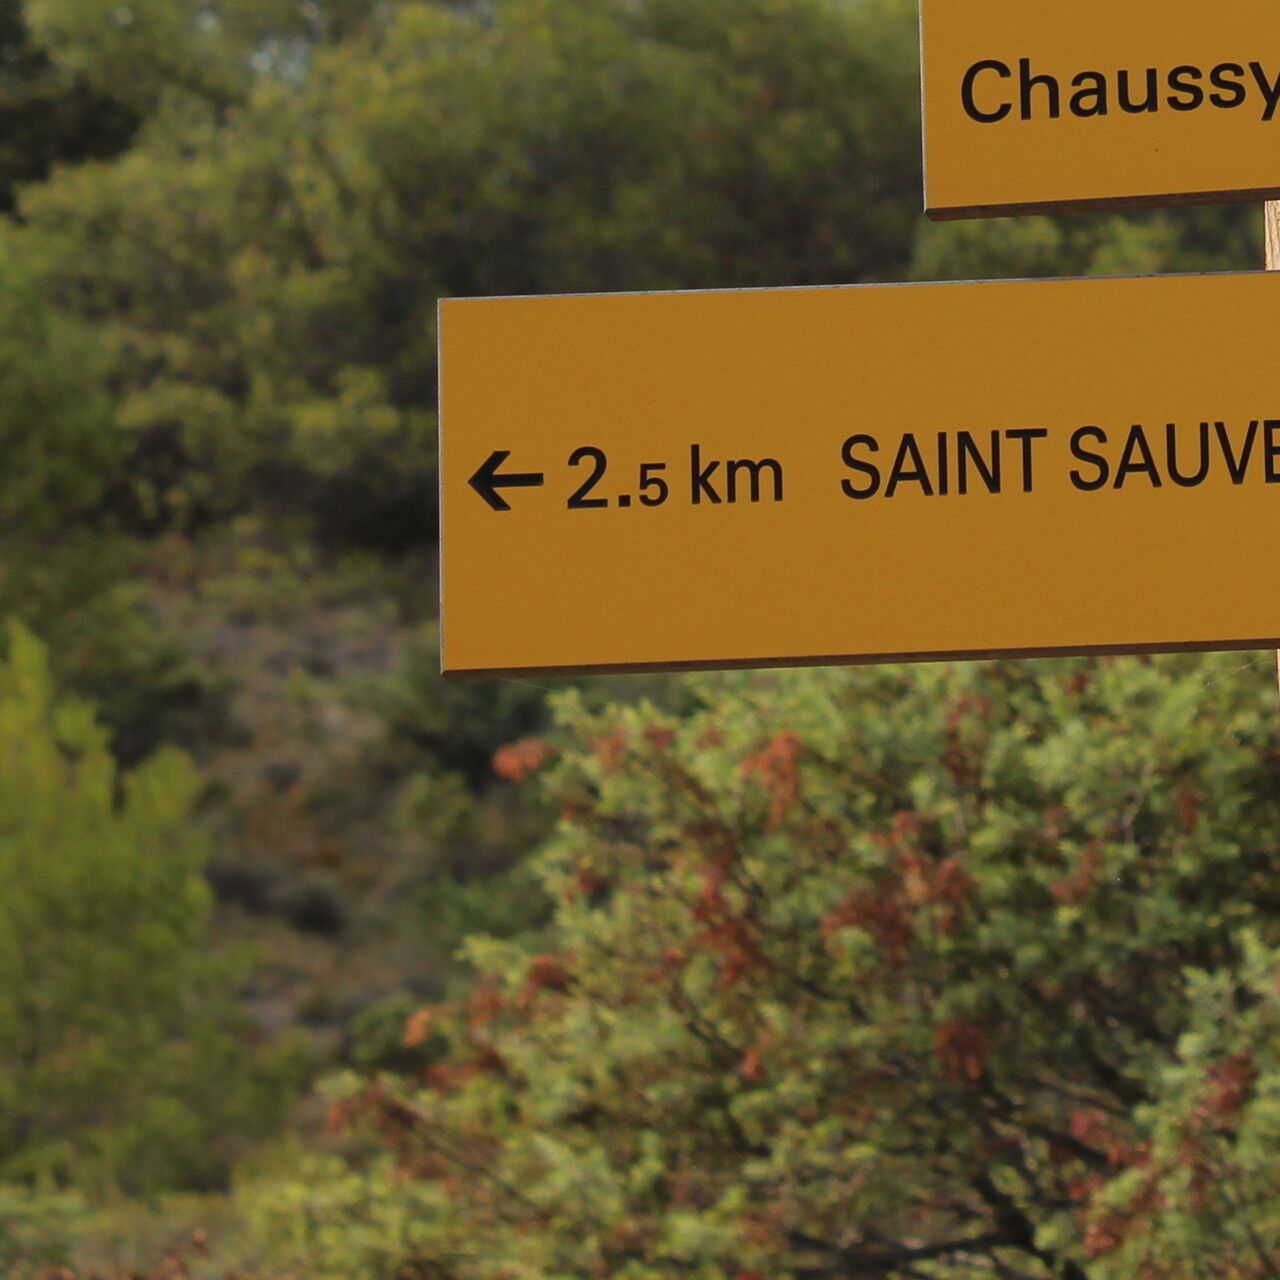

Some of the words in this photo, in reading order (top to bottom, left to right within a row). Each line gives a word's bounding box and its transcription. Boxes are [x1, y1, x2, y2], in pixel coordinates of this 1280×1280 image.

[568, 447, 668, 509] 2.5
[691, 444, 783, 504] km
[841, 428, 1047, 499] SAINT
